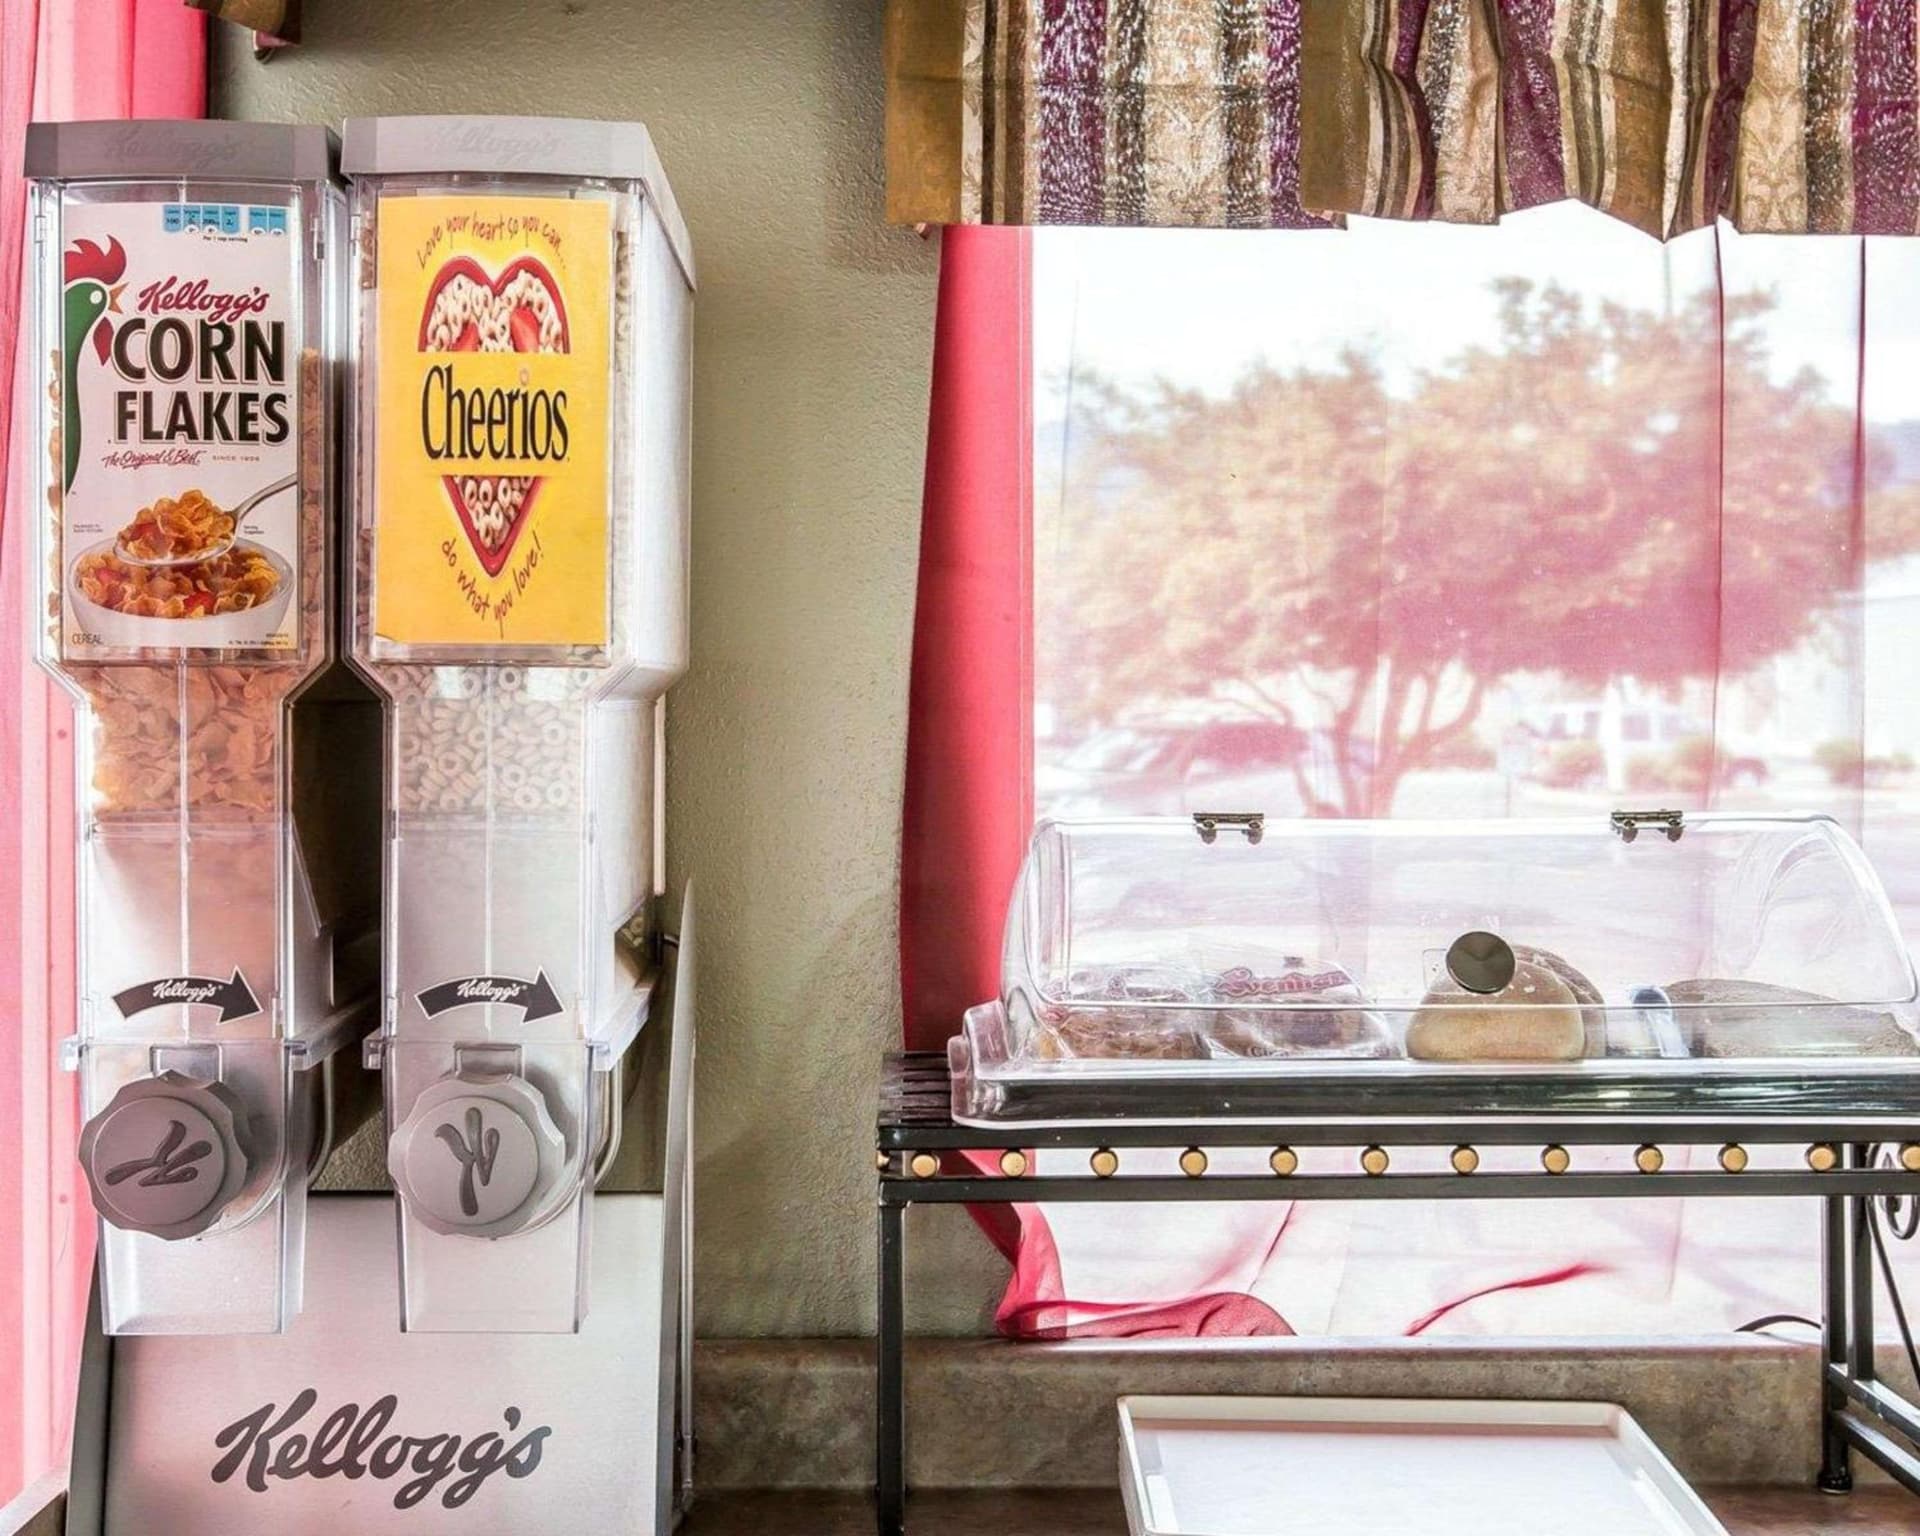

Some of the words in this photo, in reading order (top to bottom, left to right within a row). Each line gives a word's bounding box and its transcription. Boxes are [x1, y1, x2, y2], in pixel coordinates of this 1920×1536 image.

[416, 225, 443, 269] Love
[446, 215, 470, 249] your
[472, 211, 505, 241] heart
[522, 216, 540, 248] you
[138, 275, 270, 322] Kellogg's
[113, 317, 286, 383] CORN
[116, 390, 290, 444] FLAKES
[421, 363, 569, 461] Cheerios
[441, 537, 457, 567] do
[457, 571, 490, 620] what
[494, 592, 514, 639] you
[72, 633, 103, 645] CEREAL
[152, 979, 217, 1002] Kellogg's
[456, 978, 521, 1002] Kellogg's
[211, 1387, 552, 1509] Kellogg's
